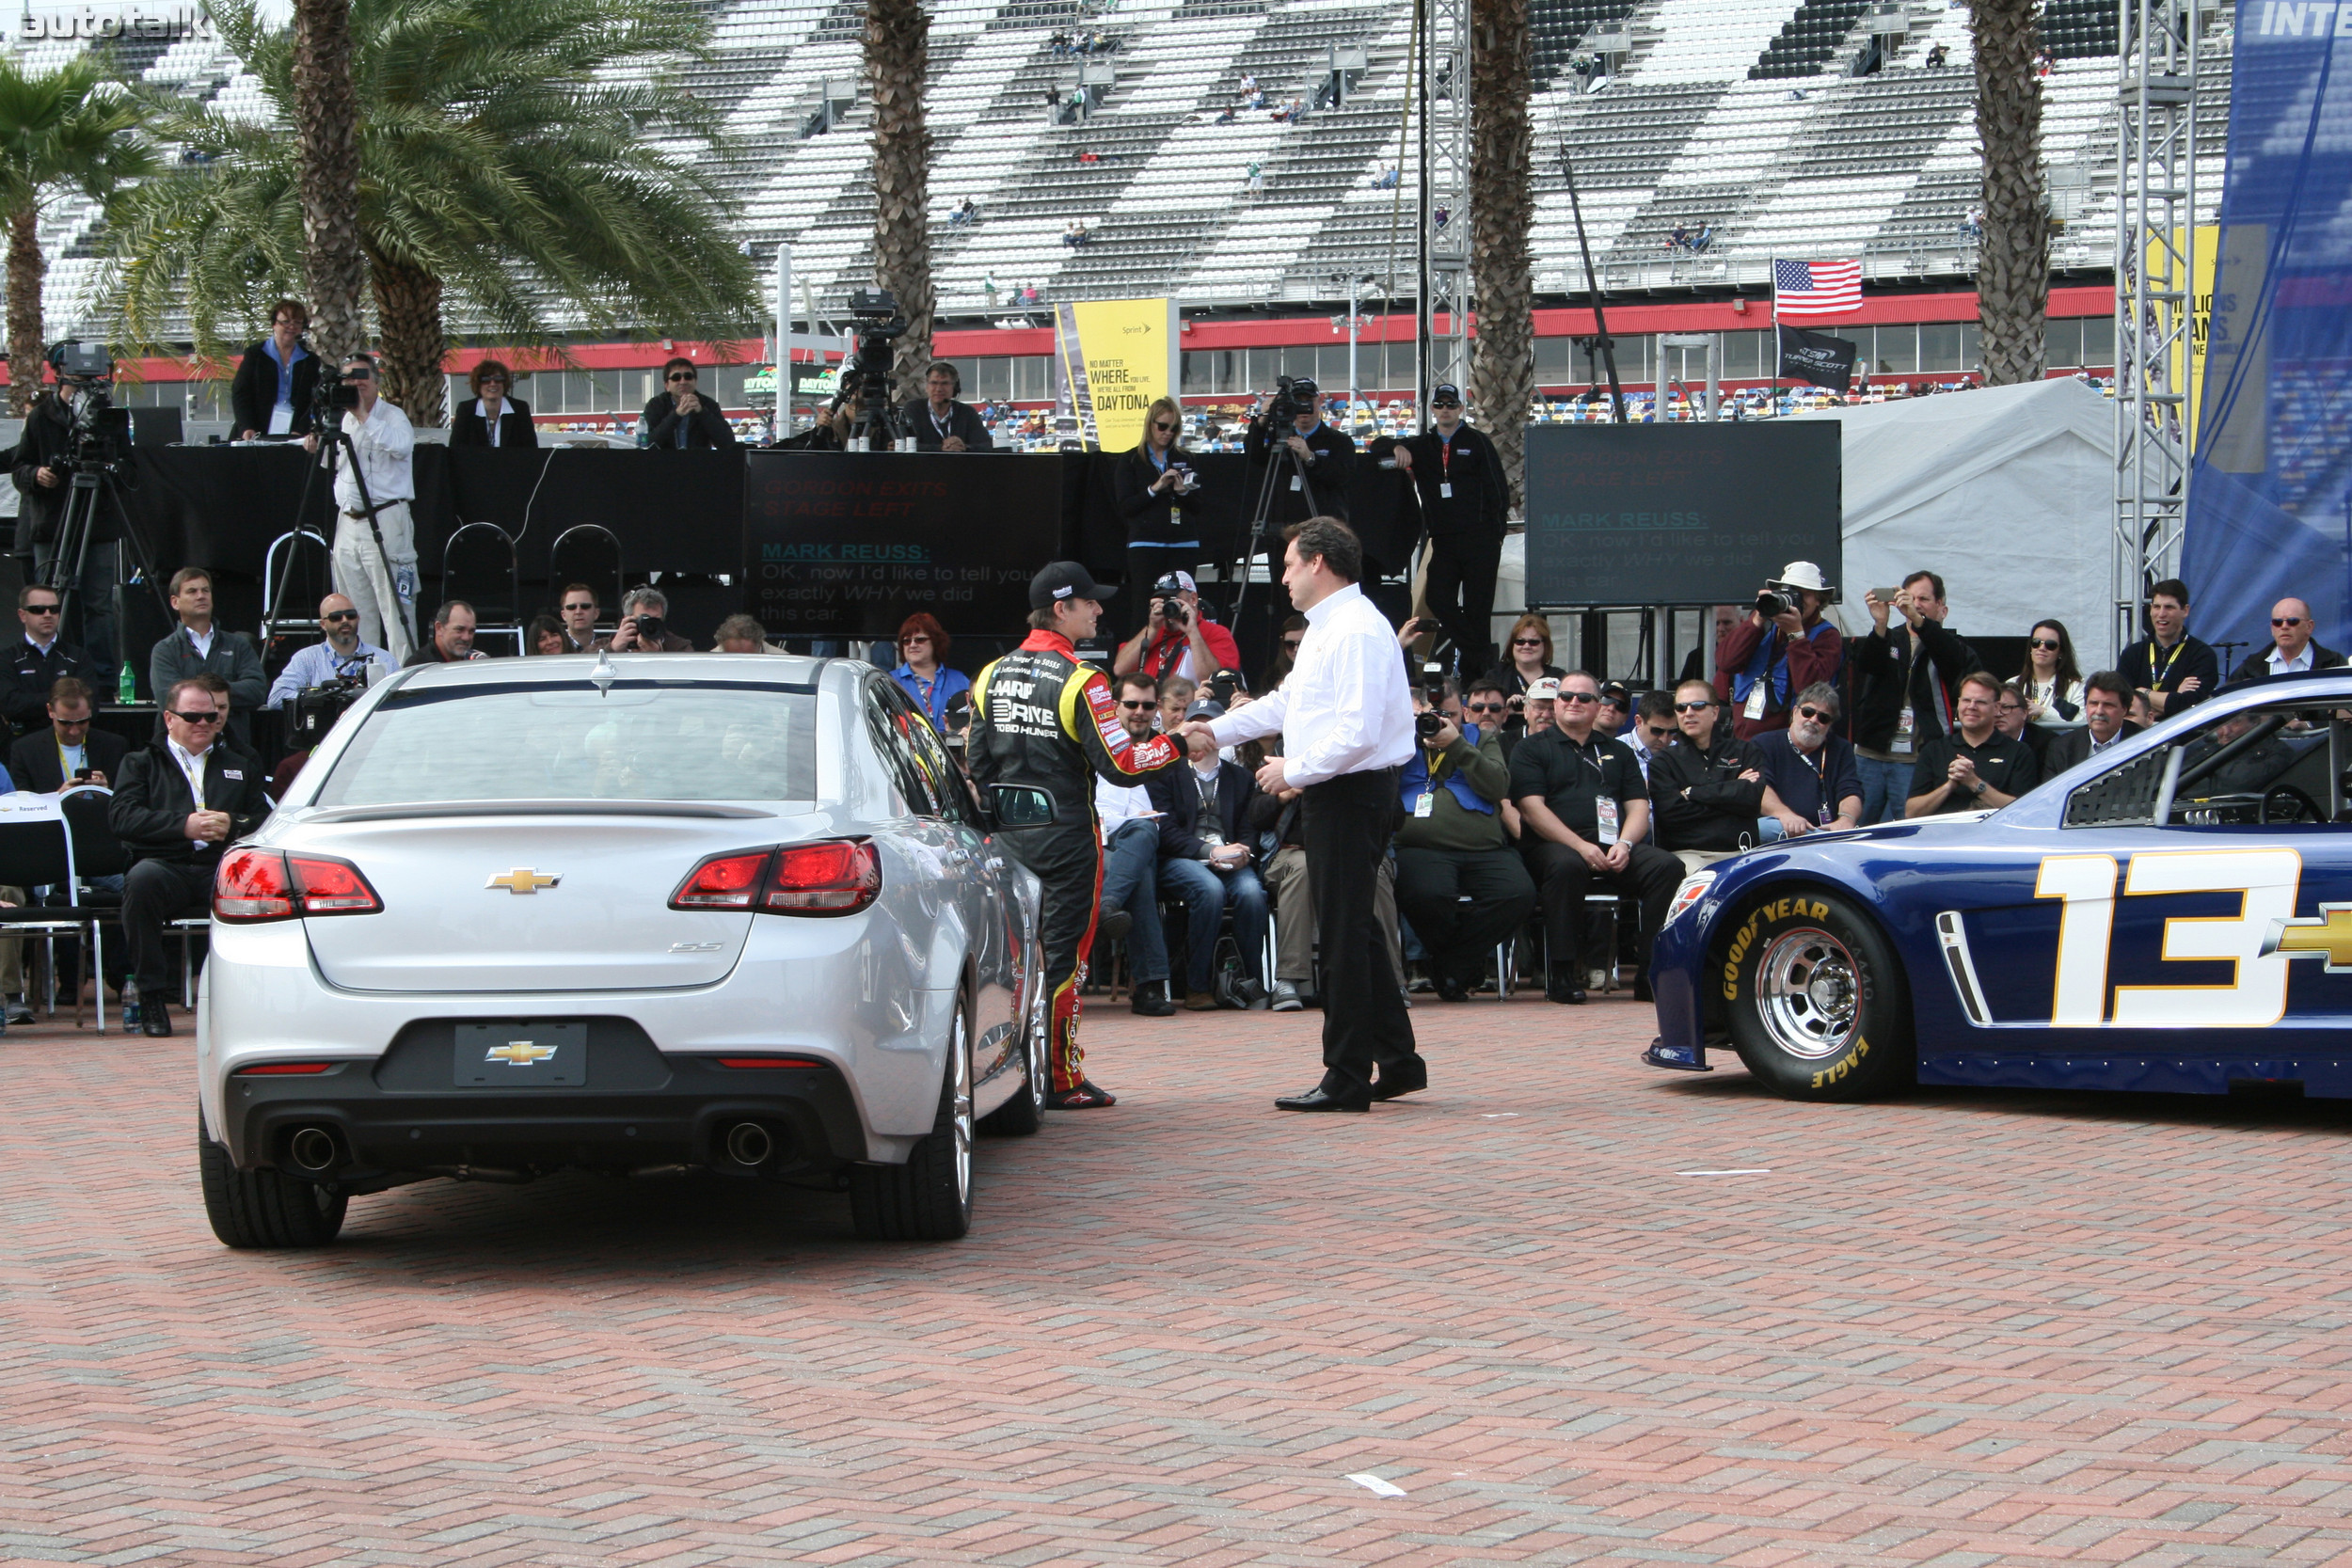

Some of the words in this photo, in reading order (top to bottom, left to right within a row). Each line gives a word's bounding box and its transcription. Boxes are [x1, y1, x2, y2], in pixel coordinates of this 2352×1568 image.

[1122, 326, 1142, 336] Sprint
[1099, 359, 1124, 368] MATTER
[1813, 361, 1849, 370] SCOTT
[1089, 369, 1130, 385] WHERE
[1097, 394, 1151, 411] DAYTONA
[764, 480, 872, 497] GORDON
[880, 482, 948, 497] EXITS
[763, 501, 847, 516] STAGE
[852, 501, 916, 517] LEFT
[1541, 514, 1611, 530] MARK
[1618, 512, 1708, 528] REUSS:
[1589, 535, 1632, 547] now
[1671, 531, 1709, 547] like
[1713, 533, 1732, 546] to
[1740, 531, 1771, 546] tell
[1774, 534, 1815, 549] you
[761, 543, 834, 560] MARK
[840, 544, 930, 561] REUSS:
[810, 567, 852, 581] now
[861, 564, 884, 581] I'd
[893, 565, 928, 581] like
[935, 567, 954, 581] to
[961, 565, 991, 581] tell
[996, 569, 1033, 585] you
[401, 584, 407, 593] P
[760, 585, 835, 603] exactly
[844, 585, 903, 600] WHY
[906, 588, 935, 601] we
[942, 585, 974, 601] did
[759, 605, 799, 621] this
[988, 680, 1033, 700] AARP
[993, 699, 1056, 726] DRIVE
[994, 723, 1005, 733] TO
[1600, 809, 1613, 817] HOT
[2034, 847, 2302, 1028] 13
[1810, 1035, 1870, 1089] EAGLE
